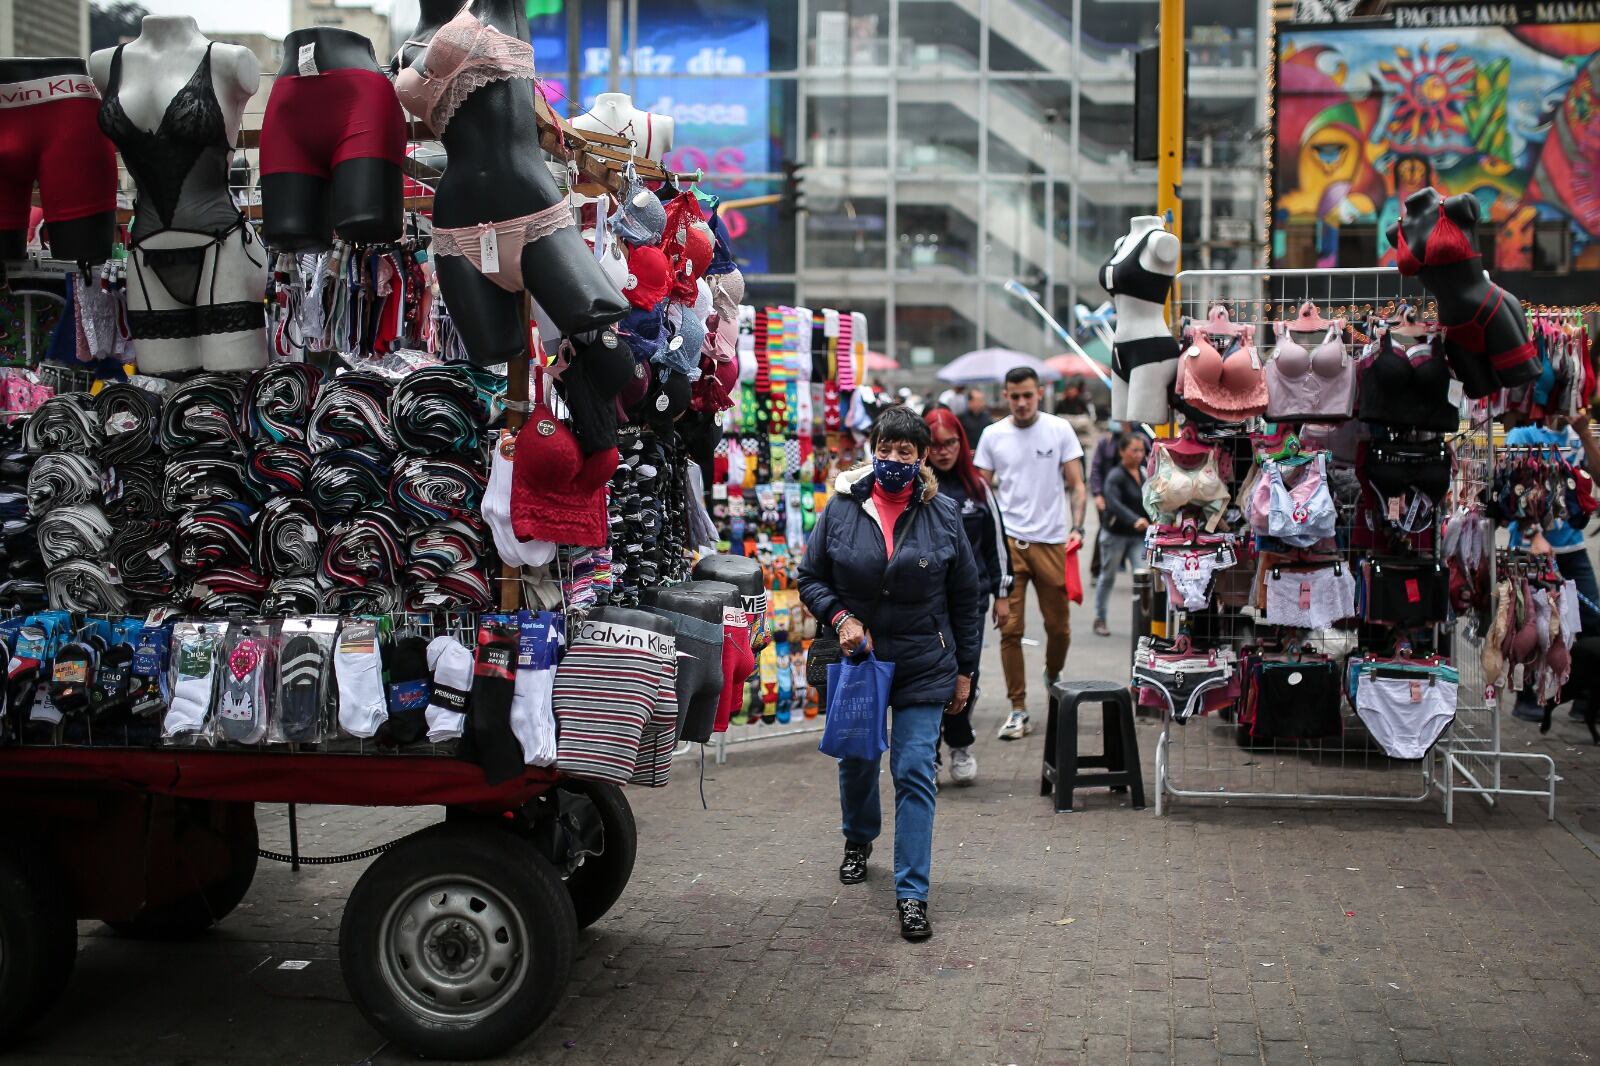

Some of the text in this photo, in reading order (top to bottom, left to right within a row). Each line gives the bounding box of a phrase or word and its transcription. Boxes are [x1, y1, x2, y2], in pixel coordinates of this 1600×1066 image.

[1395, 5, 1518, 27] PACHAMAMA
[197, 485, 209, 496] ck
[184, 545, 196, 556] ck
[357, 546, 370, 560] ck
[581, 624, 675, 657] Calvin Klein
[487, 657, 510, 666] SPORT
[102, 673, 121, 681] LOLO
